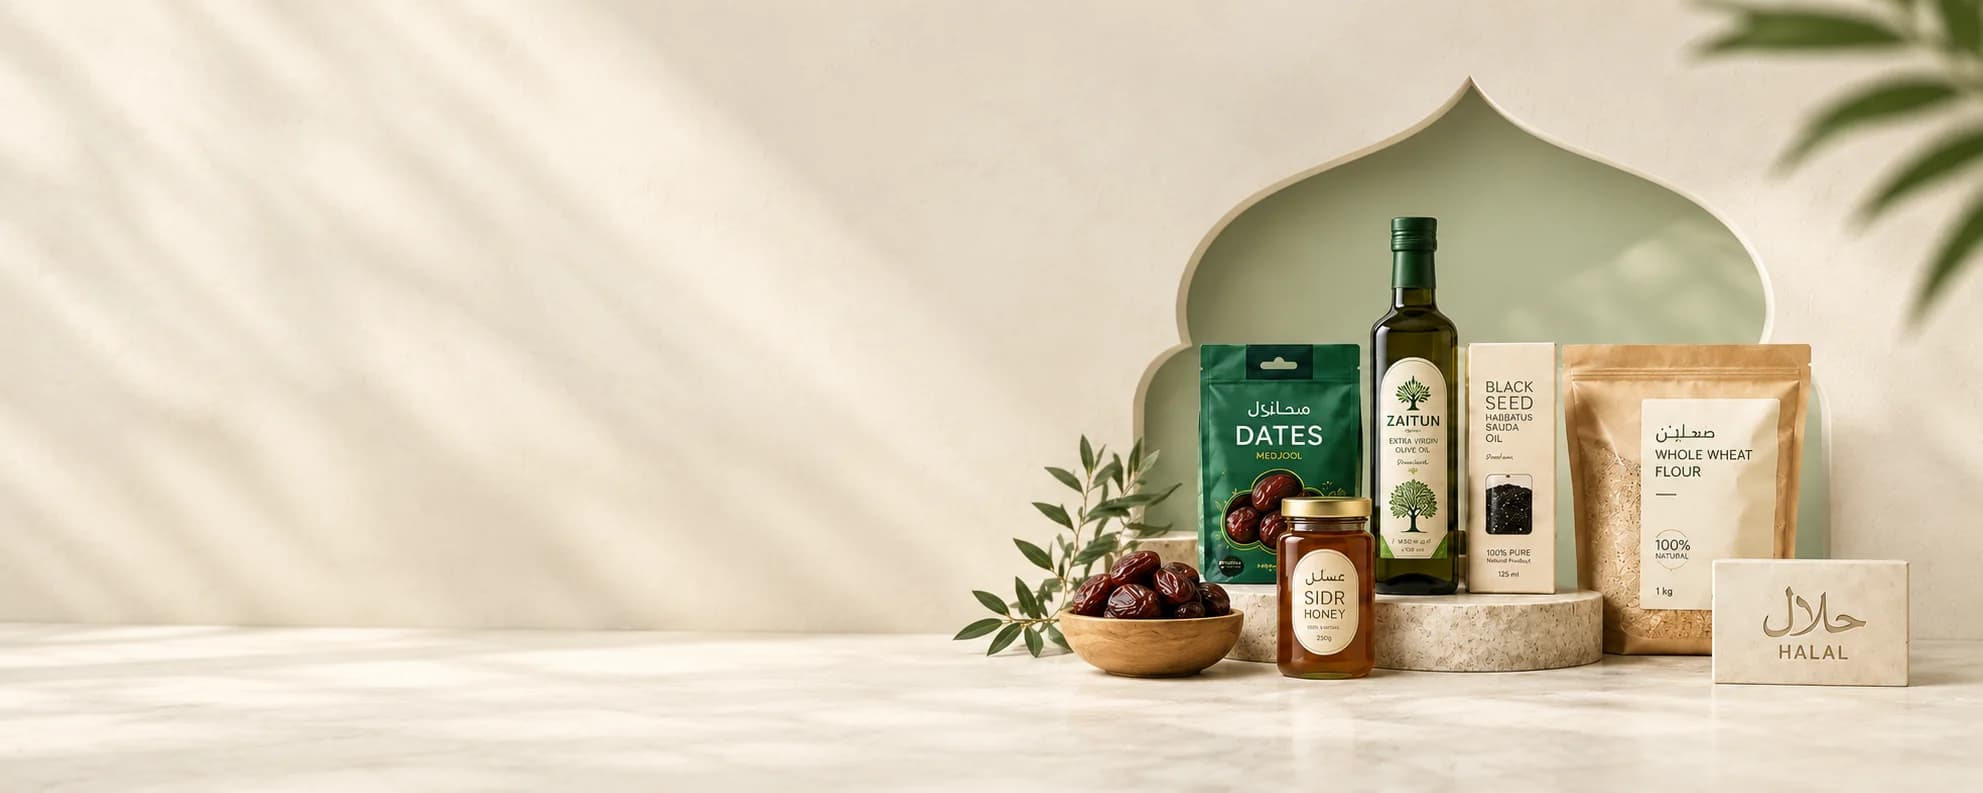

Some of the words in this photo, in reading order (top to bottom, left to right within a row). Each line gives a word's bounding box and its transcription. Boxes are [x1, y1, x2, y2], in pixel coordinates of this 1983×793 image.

[1485, 380, 1534, 393] BLACK
[1485, 395, 1534, 411] SEED
[1386, 415, 1440, 427] ZAITUN
[1485, 422, 1520, 432] SAUDA
[1236, 425, 1324, 446] DATES
[1389, 437, 1412, 445] EXTRA
[1485, 433, 1503, 443] OIL
[1256, 451, 1303, 461] MEDJOOL
[1395, 446, 1417, 454] OLIVE
[1418, 446, 1431, 454] OIL
[1655, 449, 1703, 461] WHOLE
[1707, 449, 1753, 461] WHEAT
[1655, 465, 1702, 478] FLOUR
[1655, 539, 1691, 551] 100%
[1486, 548, 1507, 557] 100%
[1509, 548, 1531, 557] PURE
[1498, 570, 1509, 578] 125
[1304, 590, 1345, 606] SIDR
[1662, 587, 1673, 597] kg
[1304, 608, 1346, 620] HONEY
[1763, 586, 1867, 638] حلال
[1778, 644, 1849, 660] HALAL
